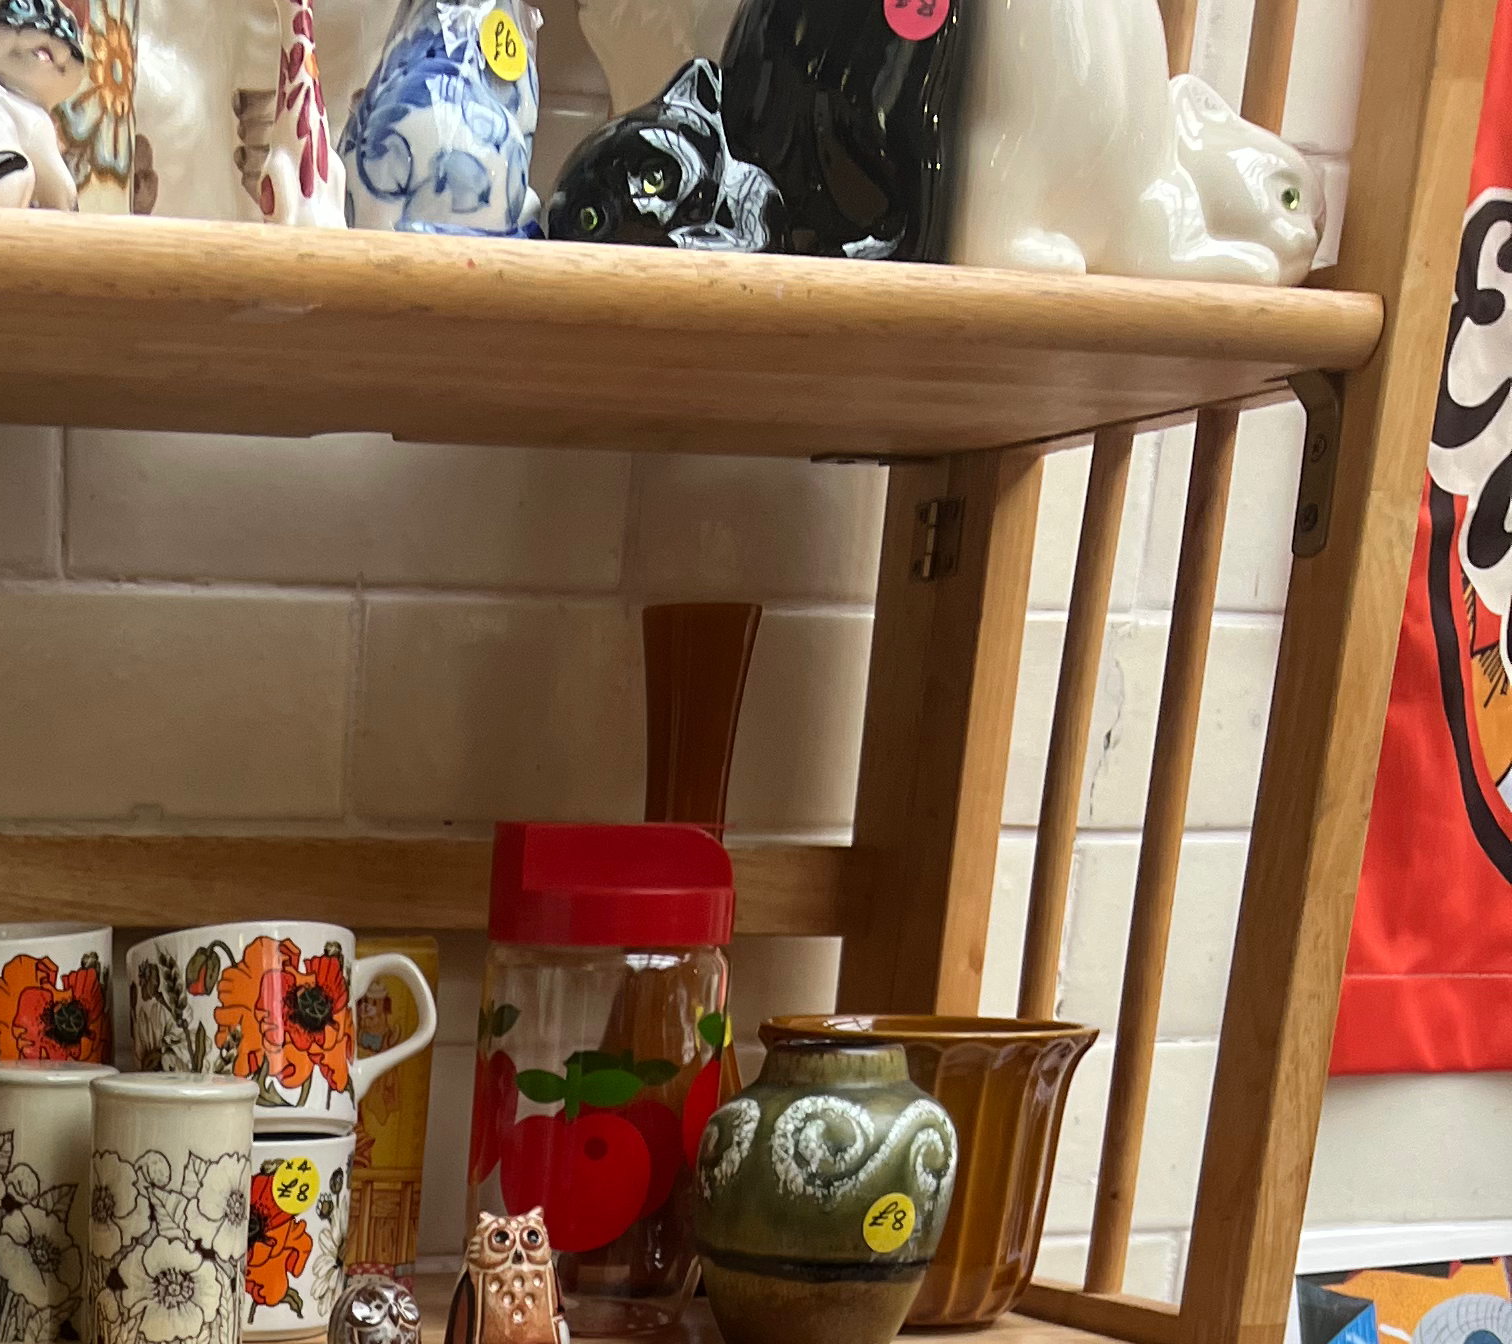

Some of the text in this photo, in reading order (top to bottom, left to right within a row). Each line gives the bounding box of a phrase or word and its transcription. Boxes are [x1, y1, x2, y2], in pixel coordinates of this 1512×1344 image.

[494, 20, 516, 61] £6
[277, 1178, 309, 1202] £8
[869, 1201, 906, 1231] £8
